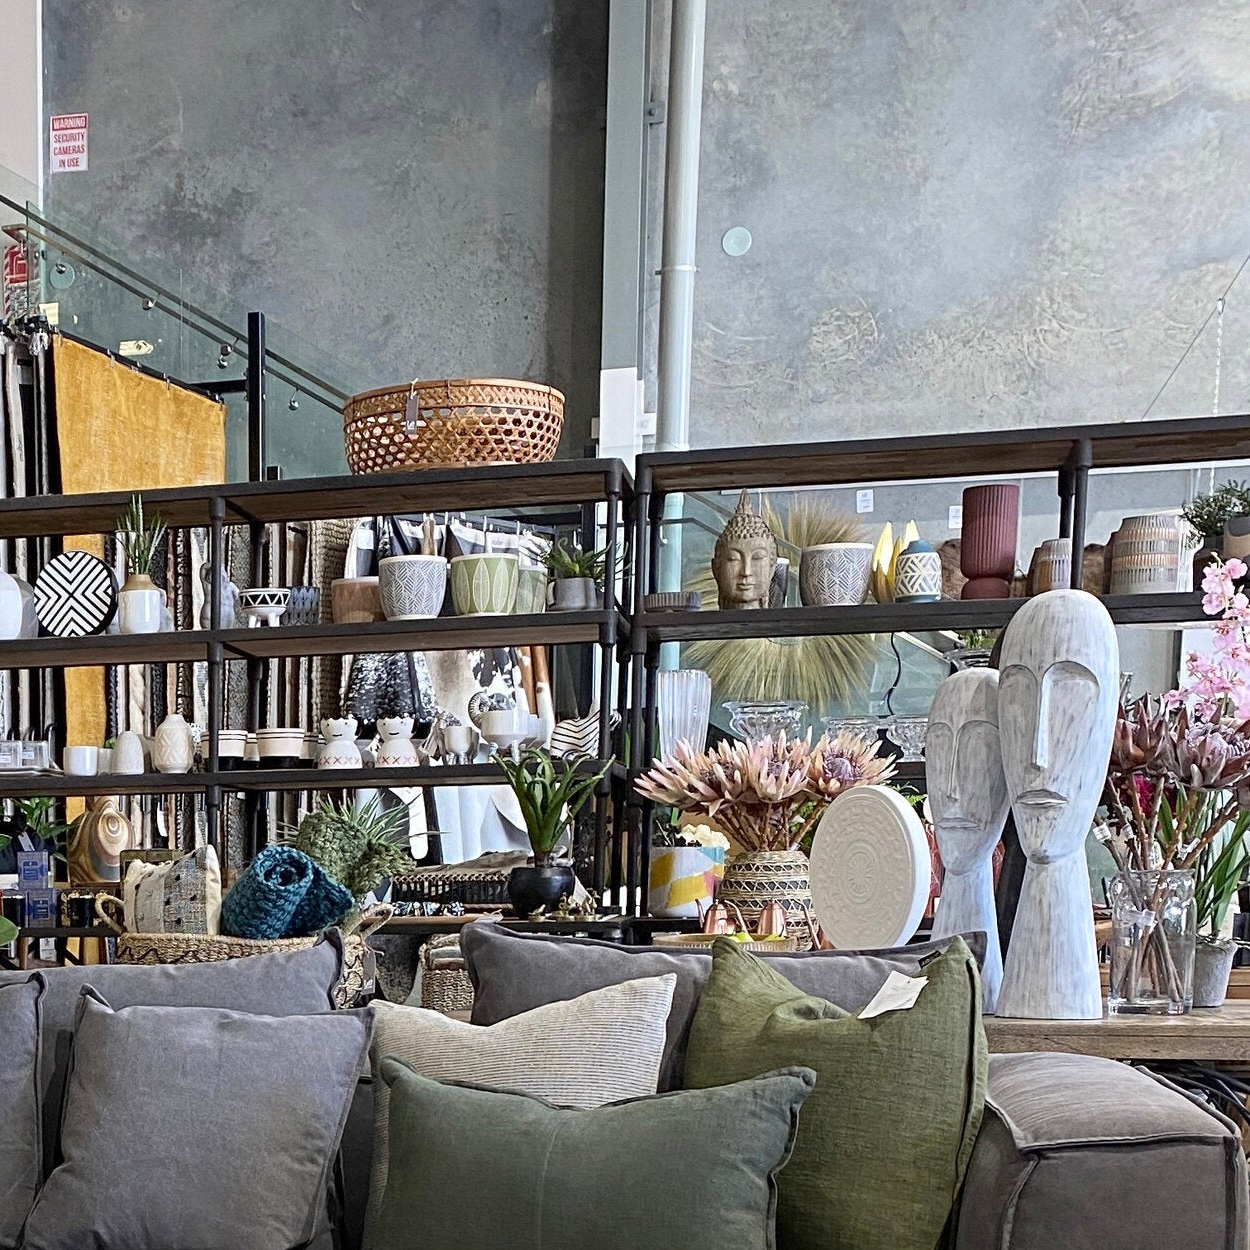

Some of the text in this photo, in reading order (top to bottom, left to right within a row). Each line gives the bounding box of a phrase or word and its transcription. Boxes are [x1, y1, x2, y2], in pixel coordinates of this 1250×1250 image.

[53, 117, 85, 130] WARNING
[54, 132, 84, 142] SECURITY
[54, 145, 85, 155] CAMERAS
[59, 157, 79, 168] IN USE
